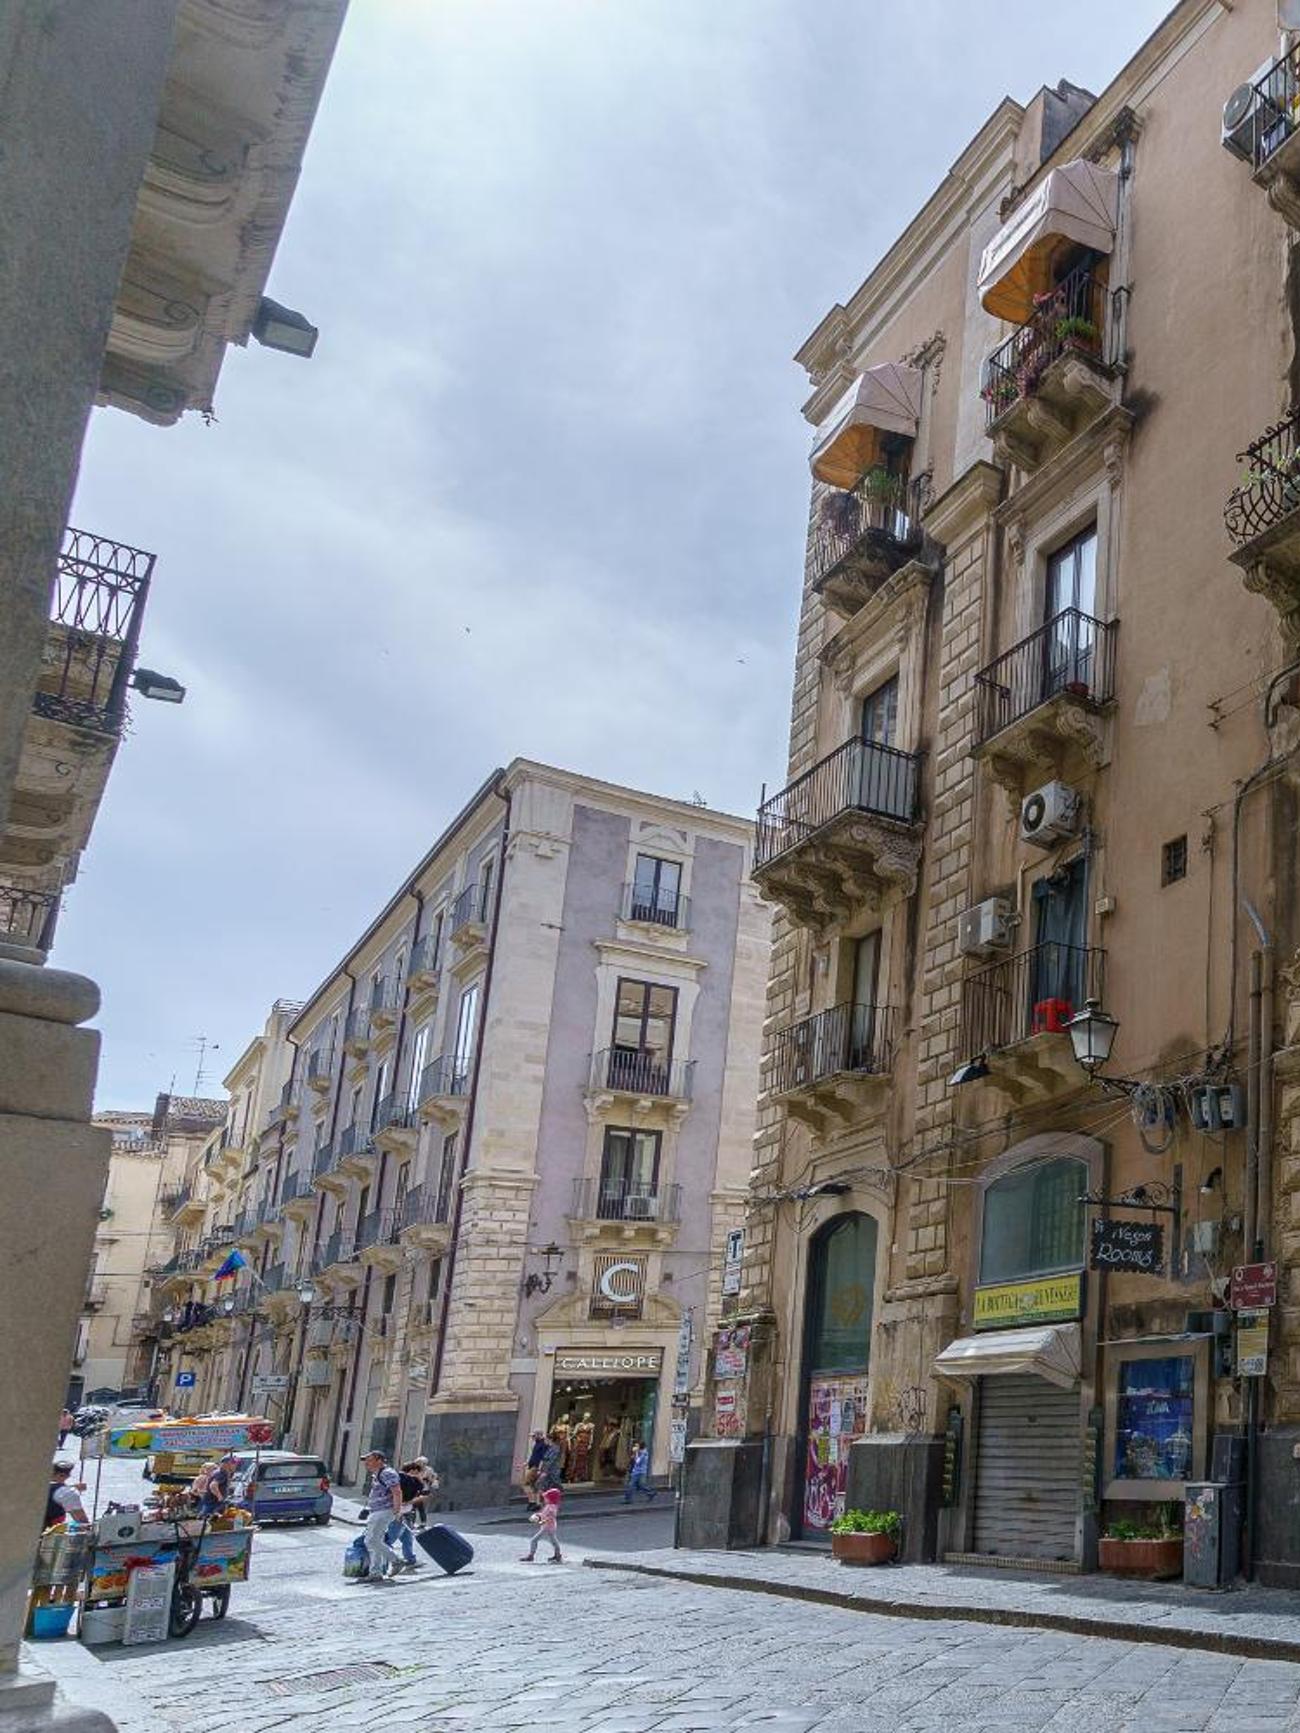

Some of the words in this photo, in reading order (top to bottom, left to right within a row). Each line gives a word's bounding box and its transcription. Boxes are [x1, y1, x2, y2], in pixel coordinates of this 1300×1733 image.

[600, 1263, 638, 1302] C
[562, 1357, 657, 1368] CALLIOPE
[180, 1373, 193, 1385] P
